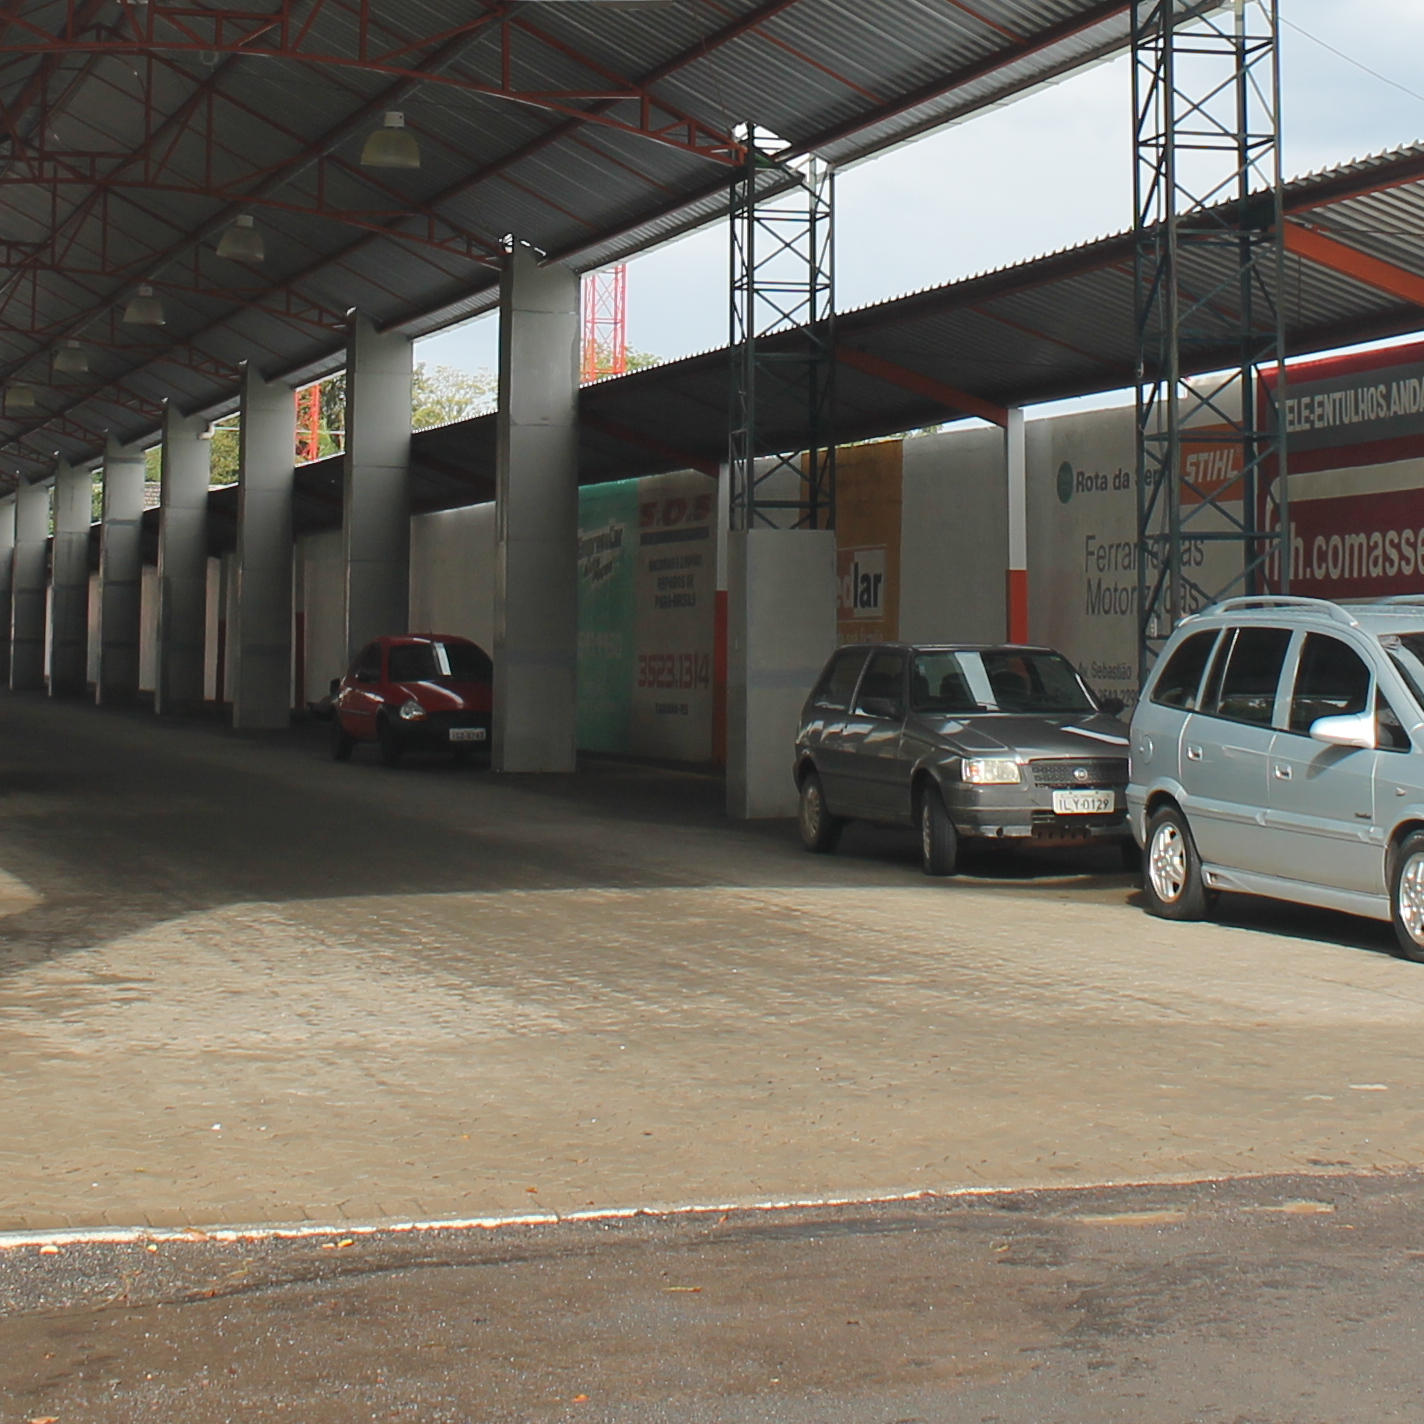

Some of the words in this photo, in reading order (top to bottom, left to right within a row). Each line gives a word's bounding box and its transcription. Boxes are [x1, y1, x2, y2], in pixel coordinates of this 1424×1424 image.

[1076, 471, 1108, 494] Rota
[1113, 467, 1130, 491] da
[1185, 448, 1239, 483] STIHL
